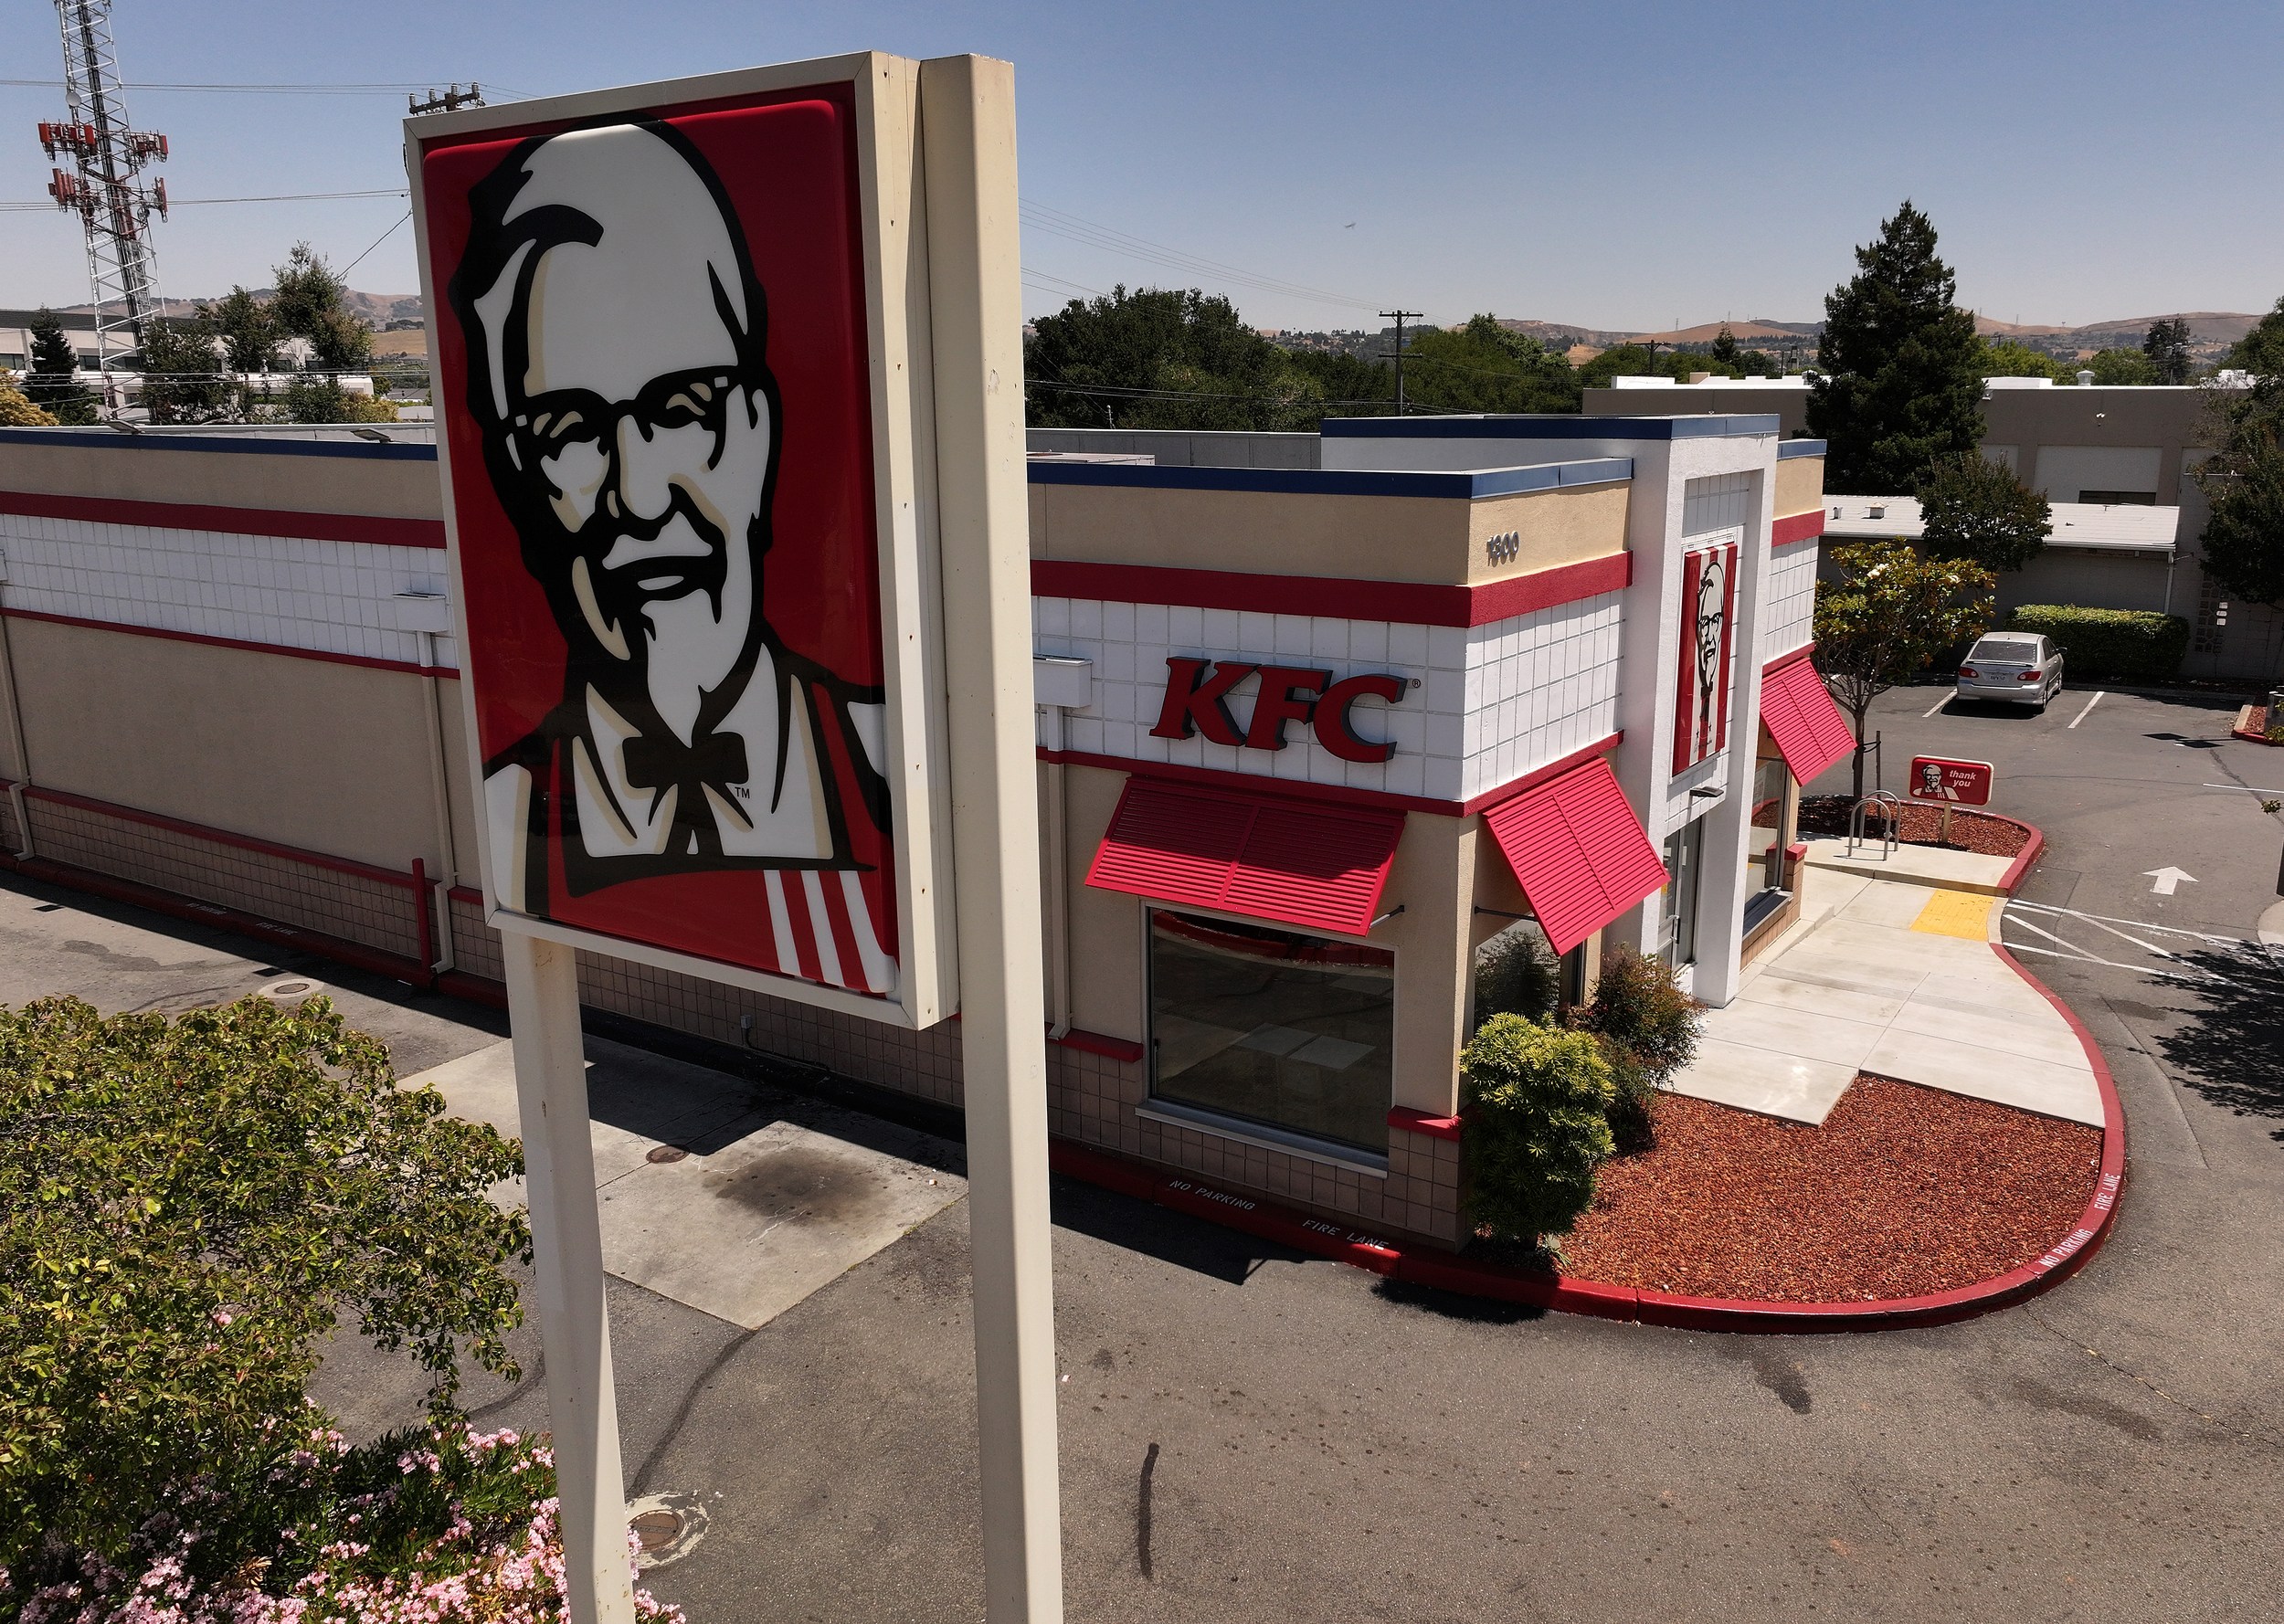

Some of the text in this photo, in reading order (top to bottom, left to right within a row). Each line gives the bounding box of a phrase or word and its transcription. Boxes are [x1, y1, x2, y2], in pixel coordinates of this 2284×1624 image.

[1148, 656, 1408, 763] KFC
[1949, 769, 1977, 780] thank
[1952, 779, 1972, 787] you
[735, 786, 750, 799] TM
[1168, 1180, 1256, 1211] NO PARKING
[2093, 1173, 2121, 1211] FIRE LANE
[1302, 1218, 1389, 1250] FIRE LANE
[2038, 1229, 2094, 1268] NO PARKING
